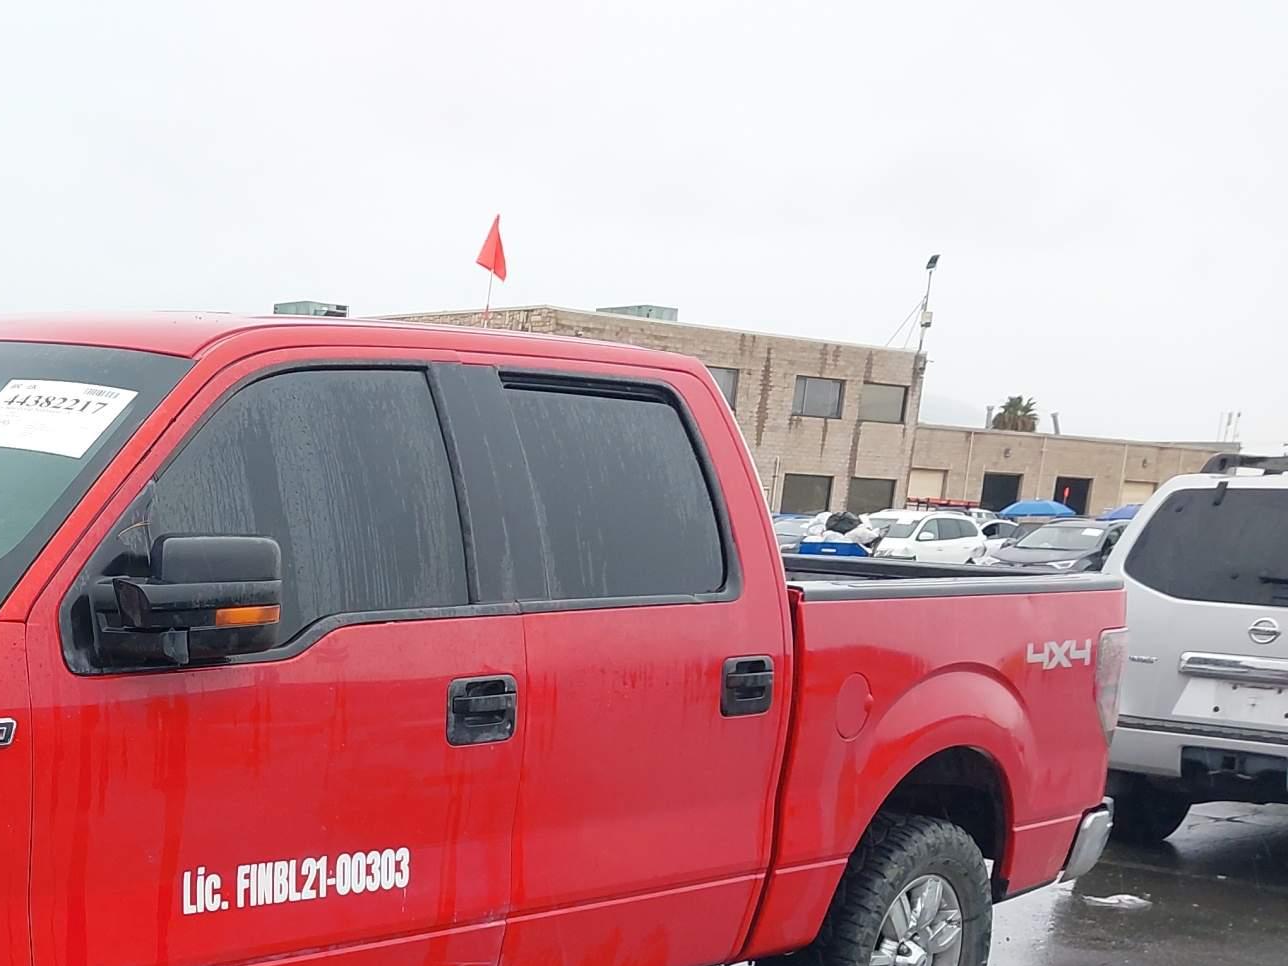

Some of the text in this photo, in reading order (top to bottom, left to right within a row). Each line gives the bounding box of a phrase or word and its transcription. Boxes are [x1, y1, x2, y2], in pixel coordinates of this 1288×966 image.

[3, 393, 109, 415] 44382217
[1026, 638, 1092, 670] 4X4
[183, 847, 410, 915] Lic. FINBL21-00303
